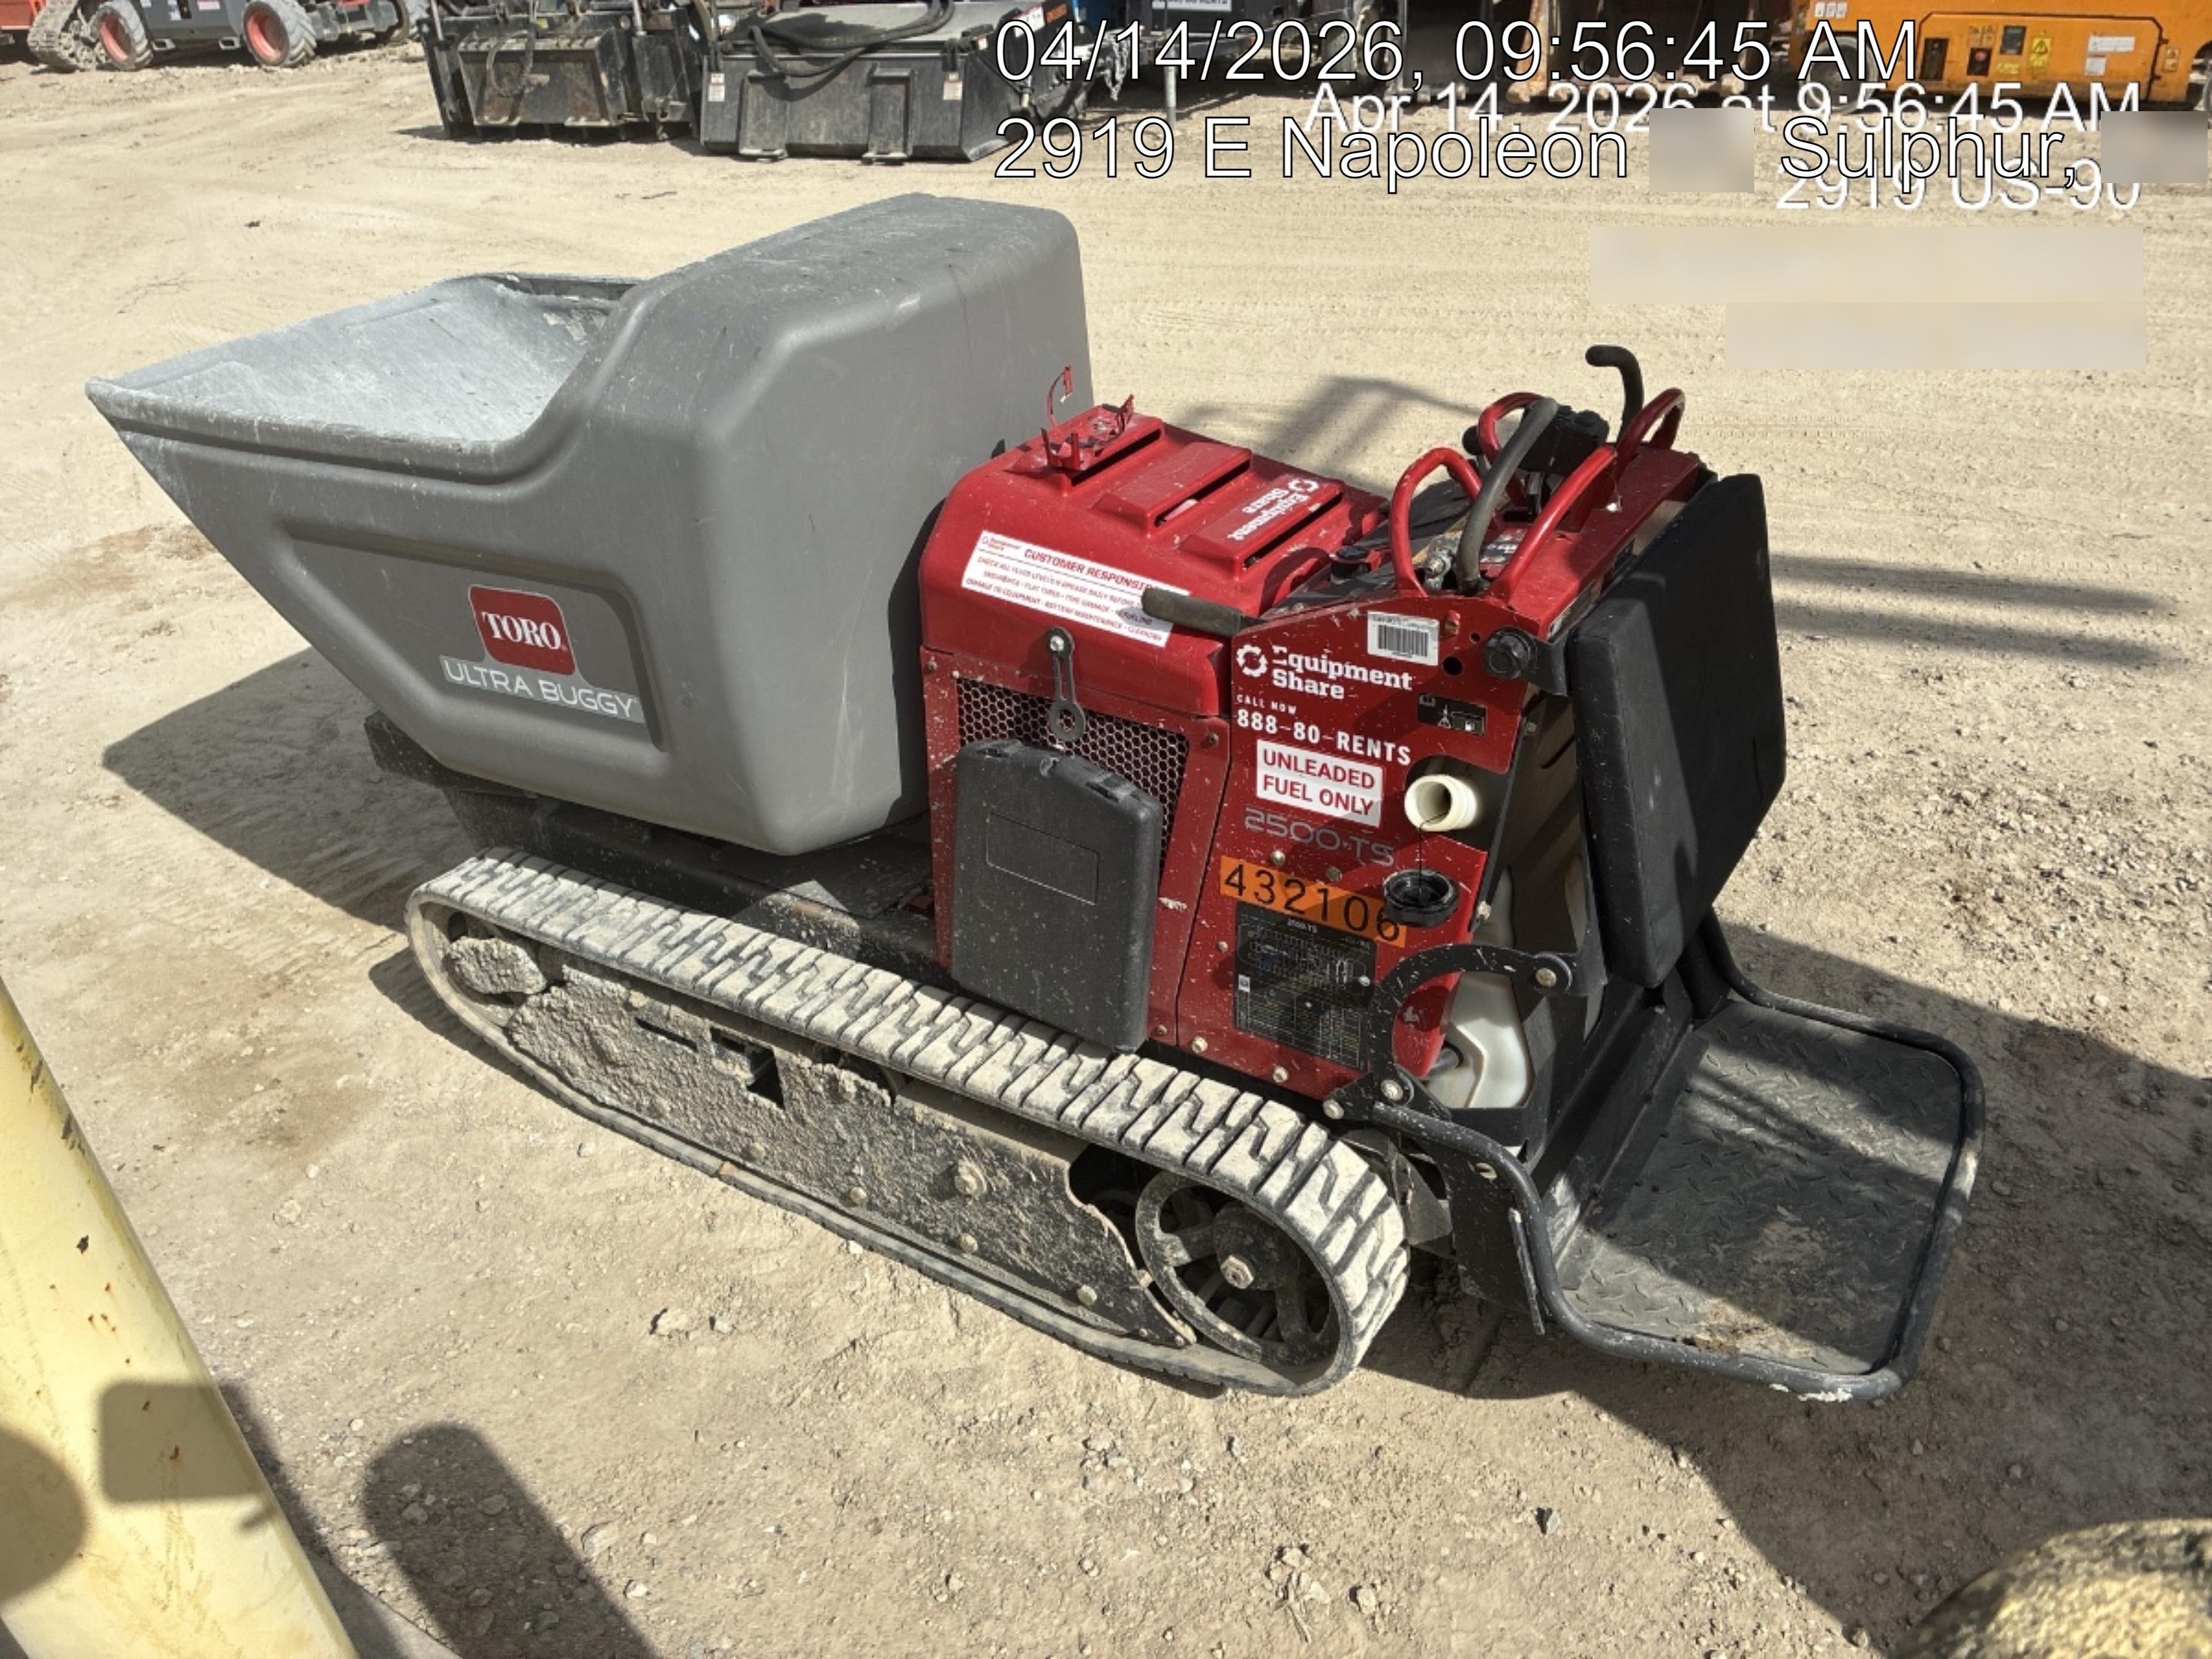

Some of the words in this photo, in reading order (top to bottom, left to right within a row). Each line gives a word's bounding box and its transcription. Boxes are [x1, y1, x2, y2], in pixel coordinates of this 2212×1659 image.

[1024, 549, 1085, 573] CUSTOMER
[482, 611, 562, 649] TORO
[444, 659, 533, 697] ULTRA
[538, 680, 635, 718] BUGGY
[1272, 645, 1413, 691] Equipment
[1273, 669, 1344, 699] Share
[1236, 694, 1265, 708] CALL
[1271, 701, 1296, 715] NOW
[1237, 709, 1411, 766] 888-80-RENTS
[1263, 748, 1375, 790] UNLEADED
[1263, 774, 1313, 802] FUEL
[1319, 788, 1375, 816] ONLY
[1224, 863, 1400, 942] 432106
